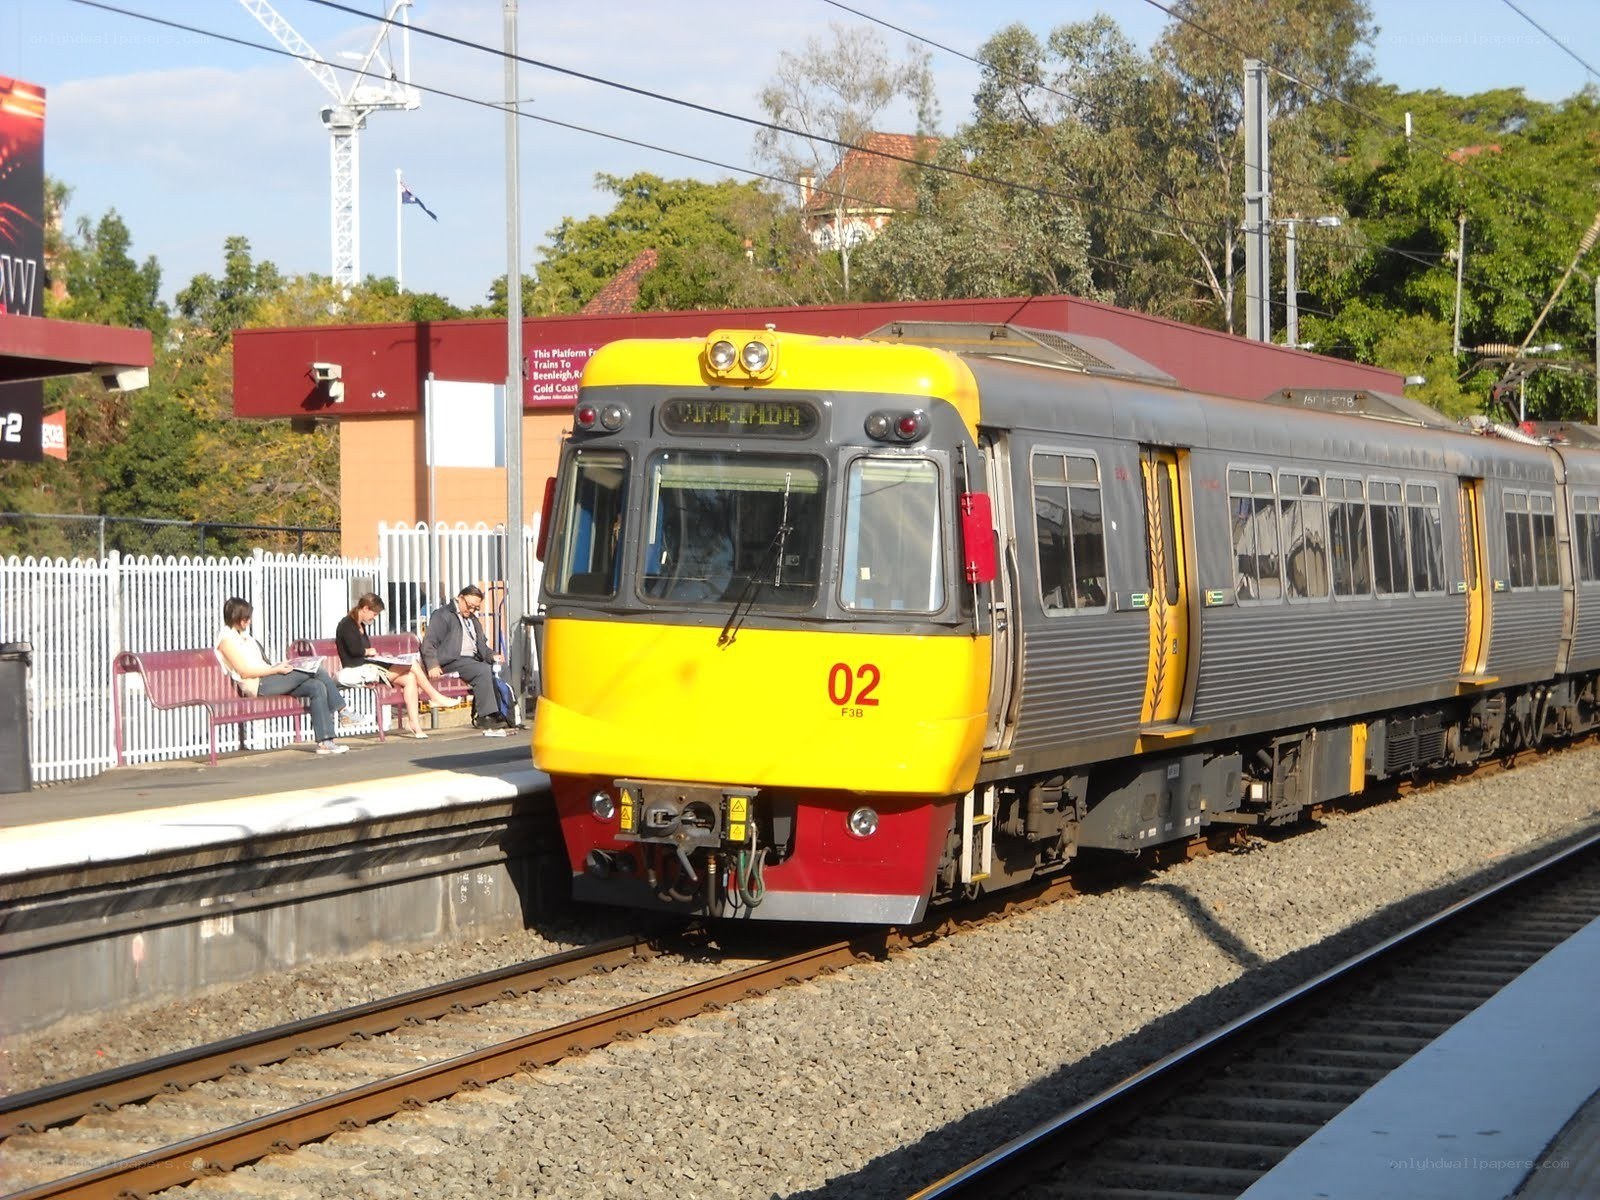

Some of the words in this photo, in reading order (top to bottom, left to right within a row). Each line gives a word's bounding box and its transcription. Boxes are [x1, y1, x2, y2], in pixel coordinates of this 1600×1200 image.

[533, 350, 550, 358] This
[552, 349, 586, 358] Platform
[533, 360, 558, 369] Trains
[560, 359, 571, 368] To
[533, 383, 554, 393] Gold
[555, 384, 578, 393] Coast
[828, 662, 880, 706] 02
[841, 707, 864, 718] F3B
